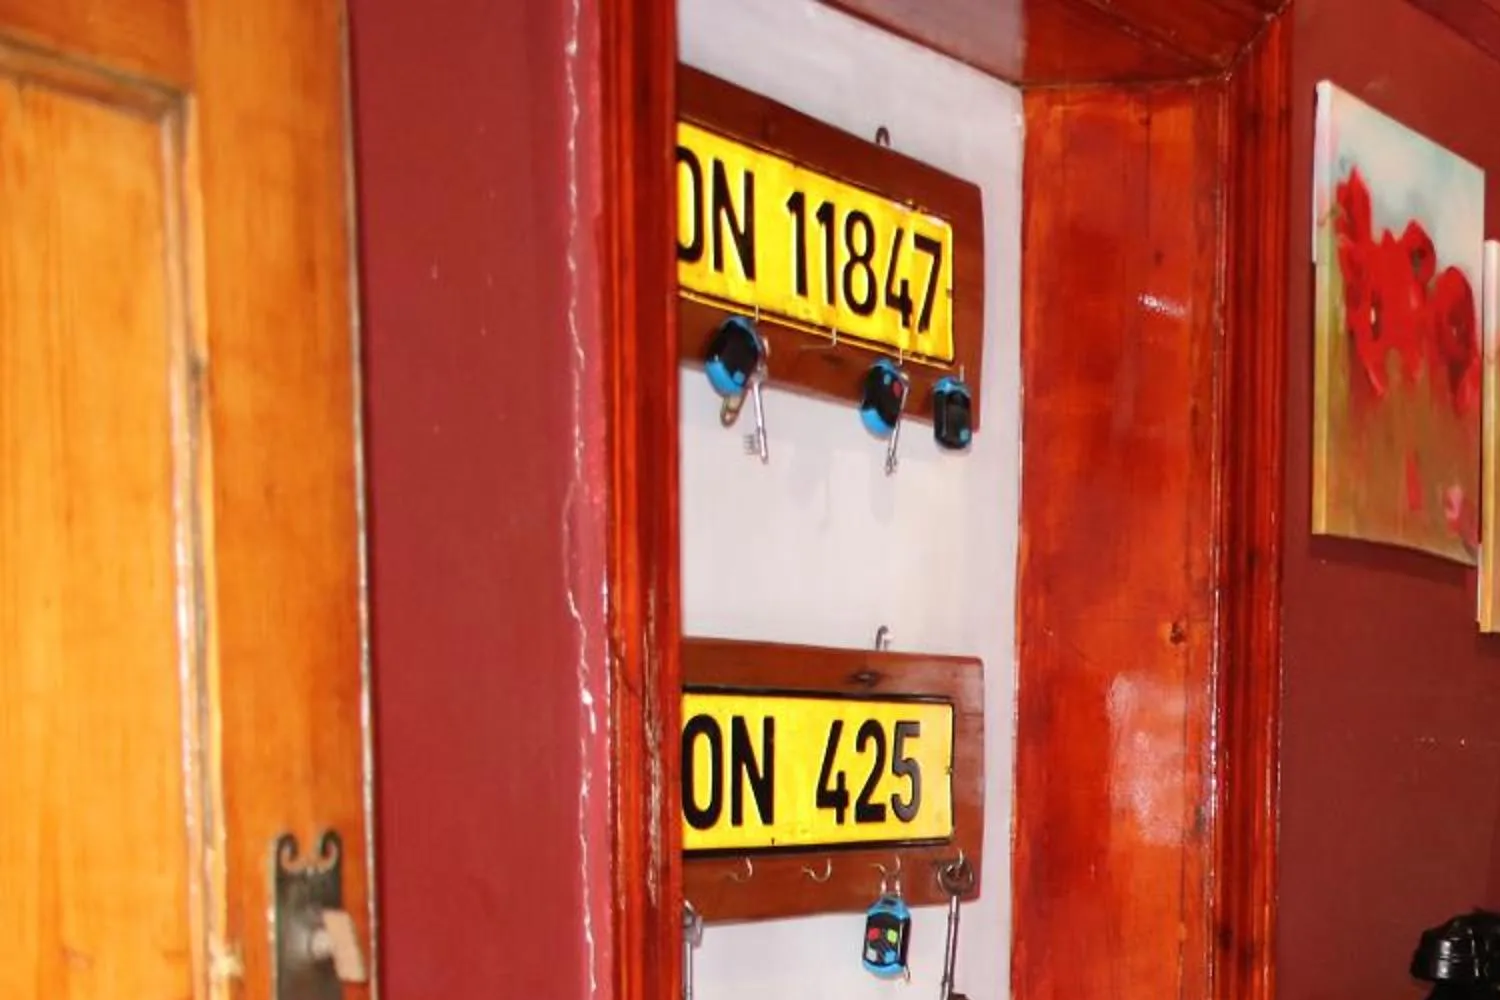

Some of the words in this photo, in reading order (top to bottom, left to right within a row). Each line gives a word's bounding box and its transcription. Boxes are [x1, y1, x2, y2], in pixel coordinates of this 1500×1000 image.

[786, 191, 942, 334] 11847
[682, 714, 775, 829] ON
[815, 719, 922, 824] 425
